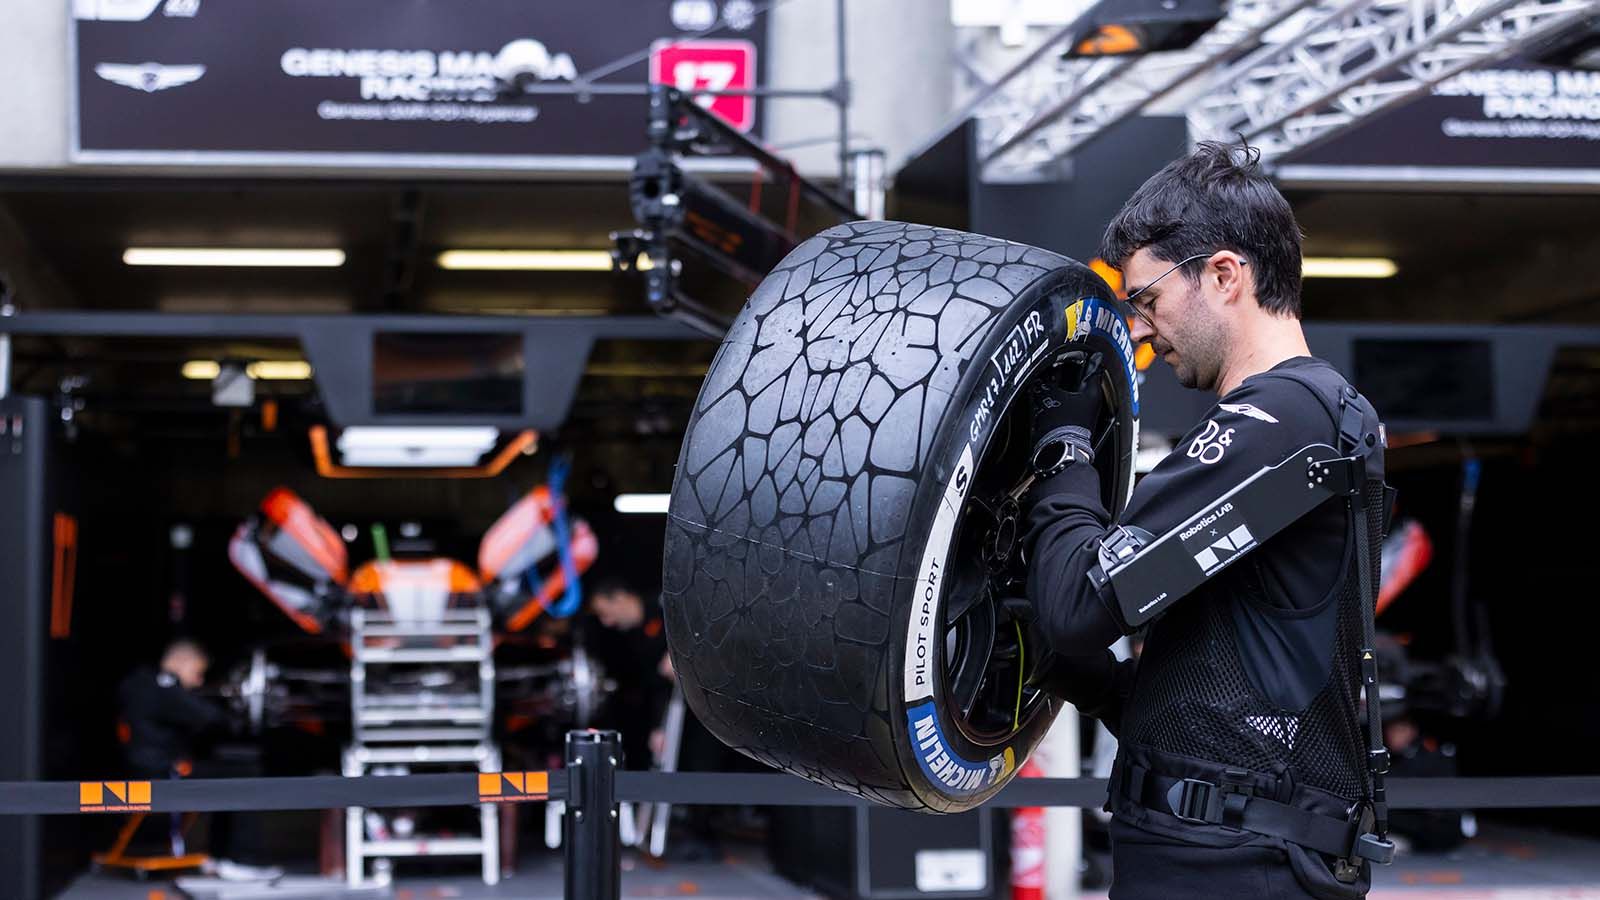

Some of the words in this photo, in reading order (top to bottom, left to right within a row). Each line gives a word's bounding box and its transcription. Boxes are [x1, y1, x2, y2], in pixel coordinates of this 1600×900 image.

[281, 48, 437, 76] GENESIS
[1024, 311, 1044, 344] FR
[1095, 307, 1139, 403] MICHELIN
[956, 464, 968, 498] S
[1179, 514, 1217, 541] Robotics
[1215, 502, 1234, 518] LAB
[920, 557, 939, 627] SPORT
[916, 633, 928, 686] PILOT
[915, 714, 986, 790] MICHELIN
